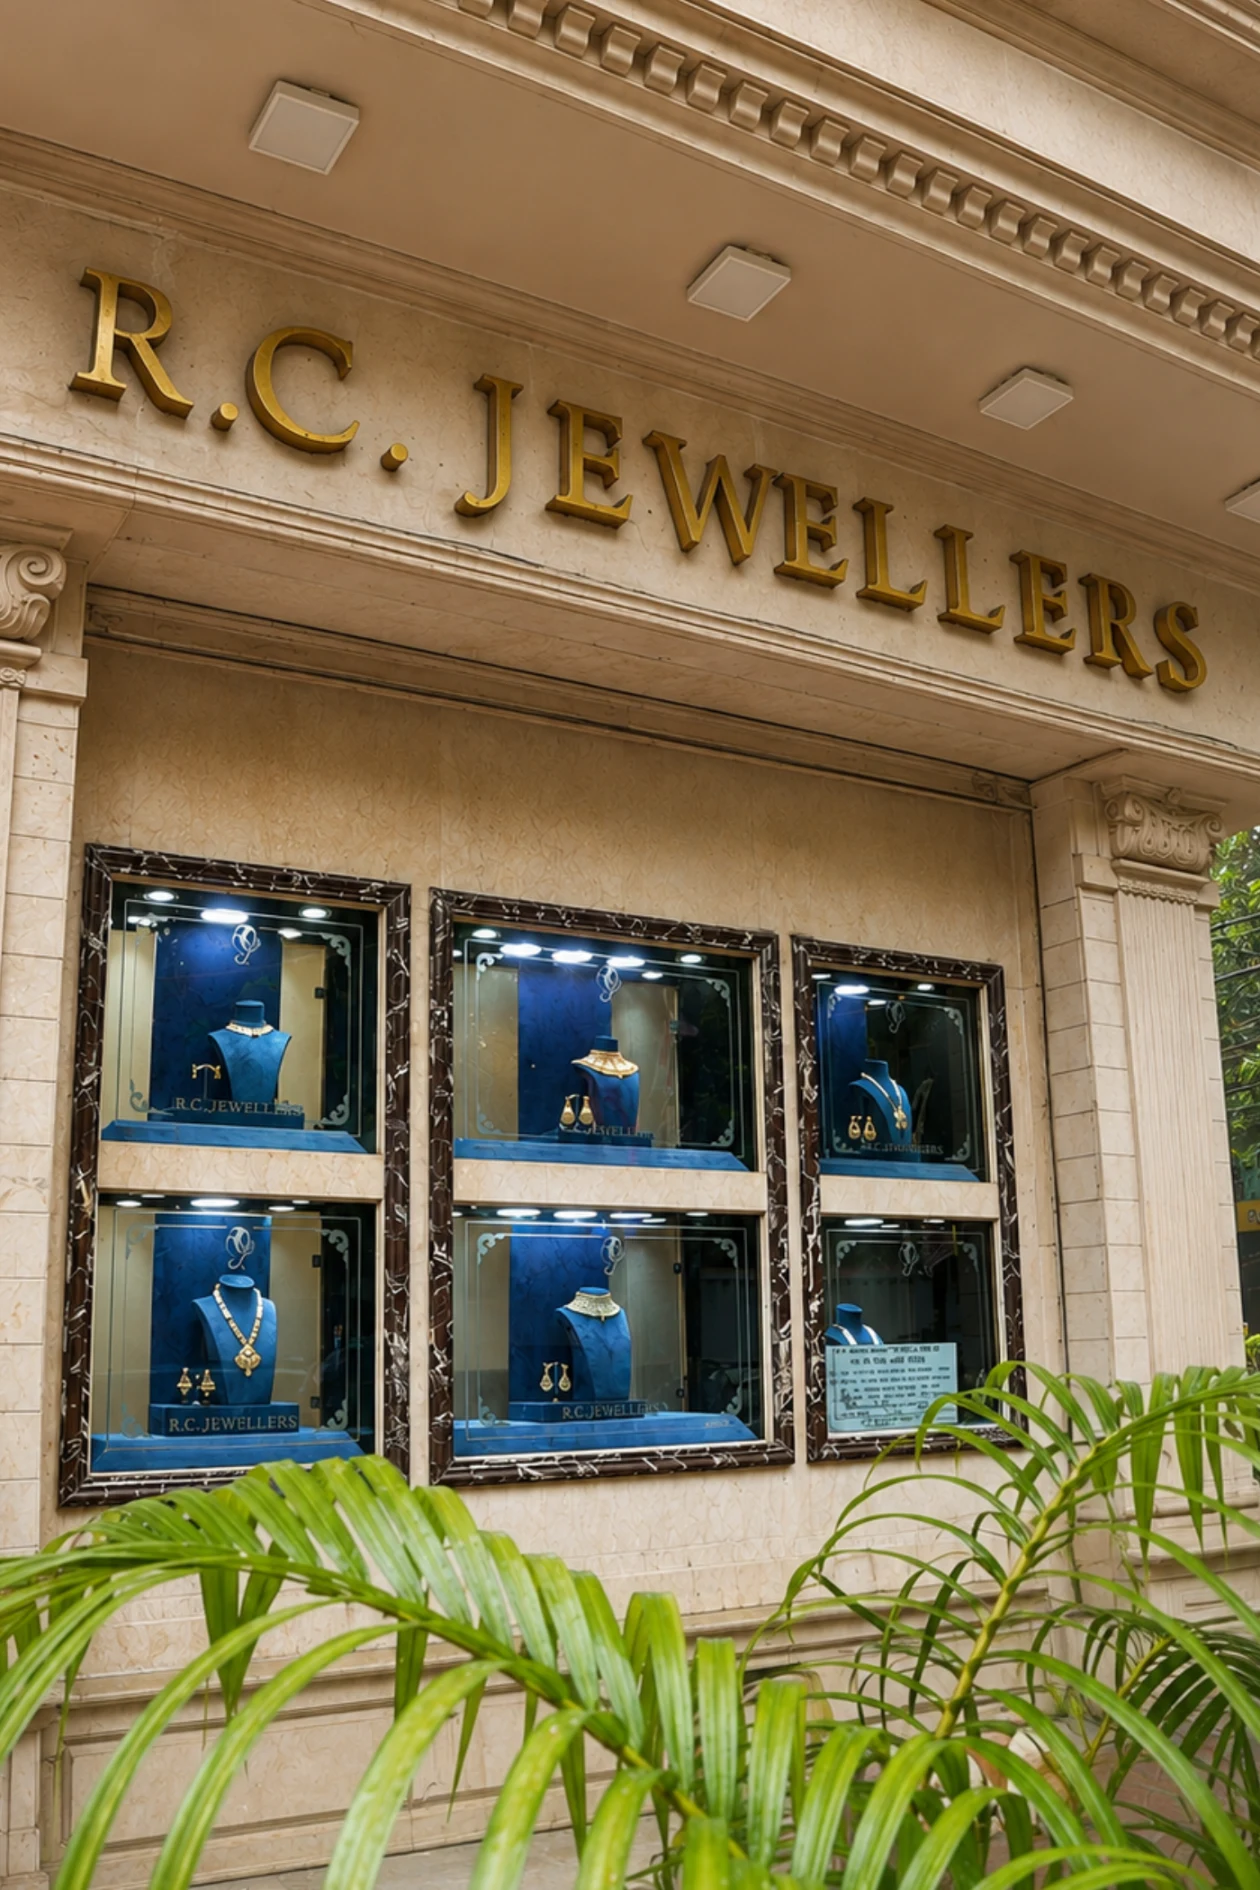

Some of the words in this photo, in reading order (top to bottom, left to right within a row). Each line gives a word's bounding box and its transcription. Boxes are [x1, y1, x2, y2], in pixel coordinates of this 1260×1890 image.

[69, 266, 409, 472] R.C.
[453, 373, 1207, 693] JEWELLERS
[202, 1414, 298, 1433] JEWELLERS
